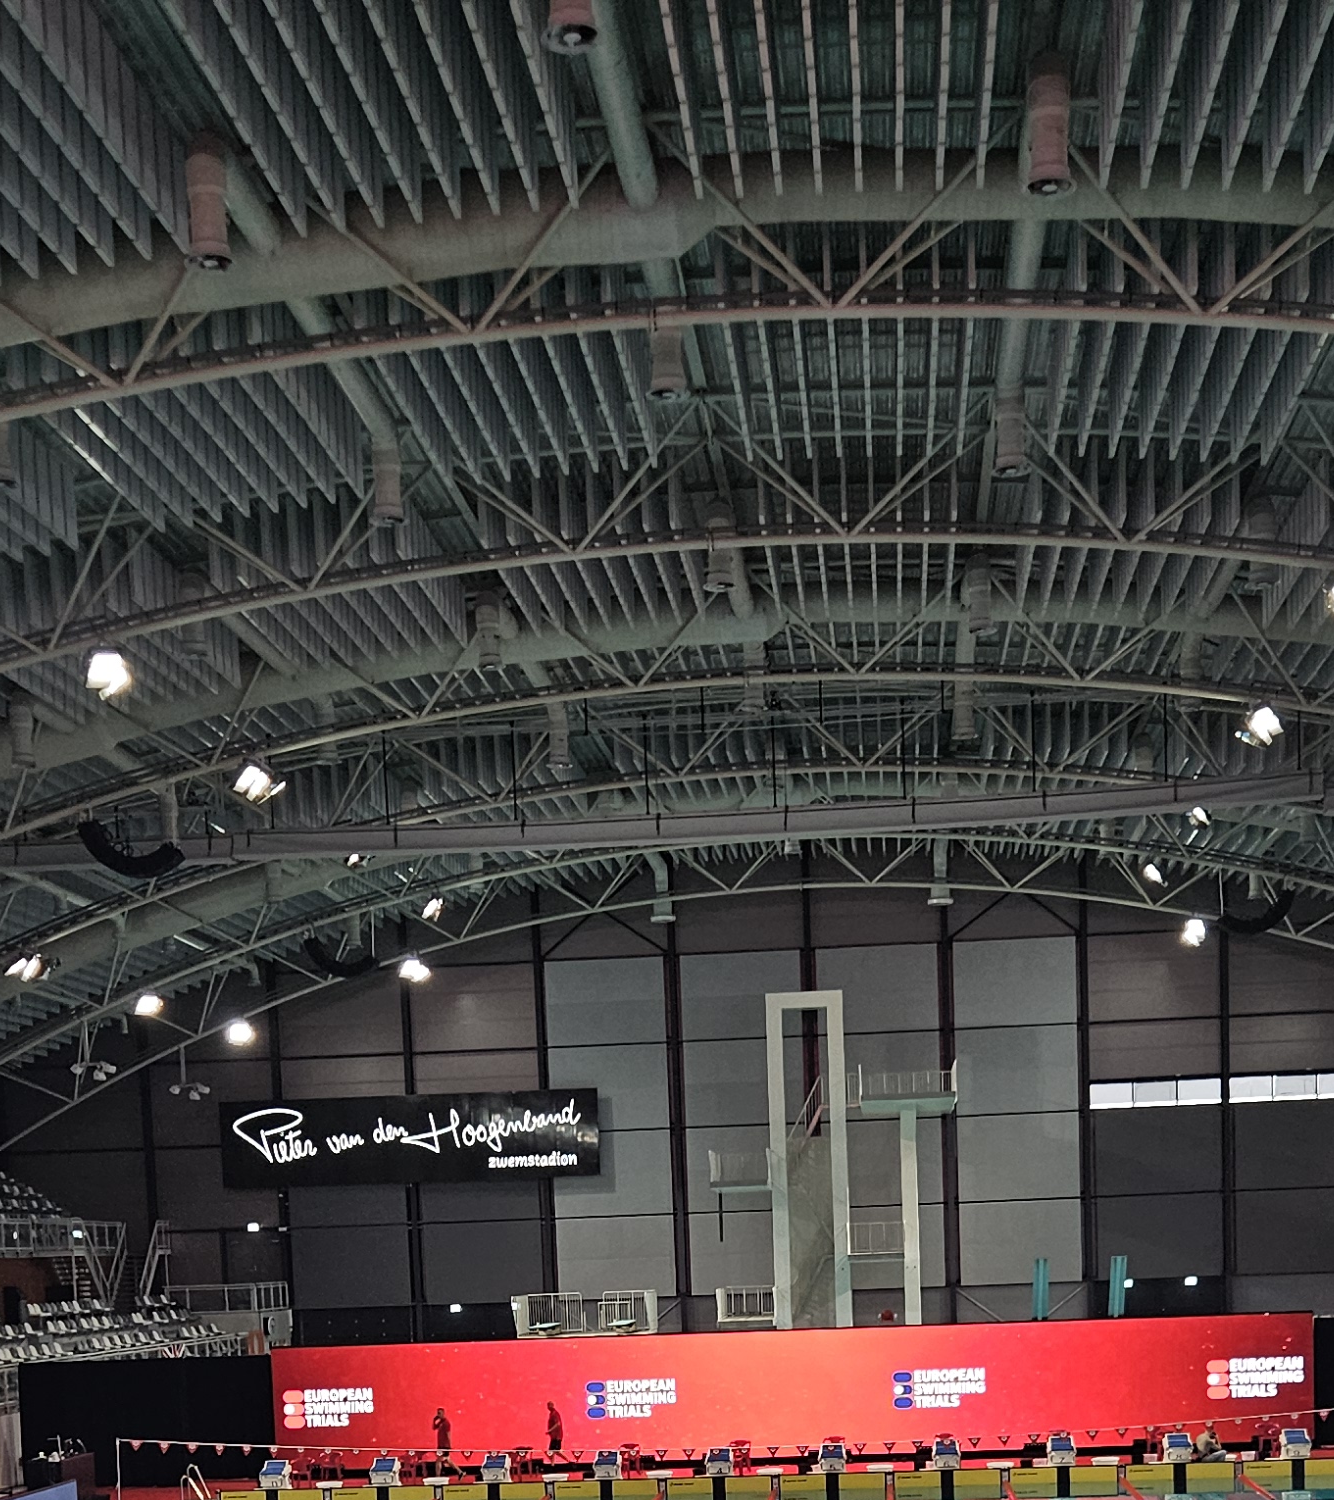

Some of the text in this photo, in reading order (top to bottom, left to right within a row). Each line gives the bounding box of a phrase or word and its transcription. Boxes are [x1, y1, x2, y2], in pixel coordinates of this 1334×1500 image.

[233, 1098, 582, 1164] Pieter van den Hoogenband
[488, 1152, 578, 1170] zwemstadion
[1229, 1357, 1304, 1372] EUROPEAN
[914, 1368, 986, 1382] EUROPEAN
[1230, 1370, 1304, 1385] SWIMMING
[607, 1378, 676, 1392] EUROPEAN
[914, 1381, 986, 1395] SWIMMING
[1230, 1384, 1277, 1398] TRIALS
[305, 1388, 373, 1402] EUROPEAN
[607, 1391, 677, 1405] SWIMMING
[915, 1394, 960, 1408] TRIALS
[305, 1401, 373, 1415] SWIMMING
[608, 1404, 652, 1417] TRIALS
[305, 1414, 349, 1427] TRIALS
